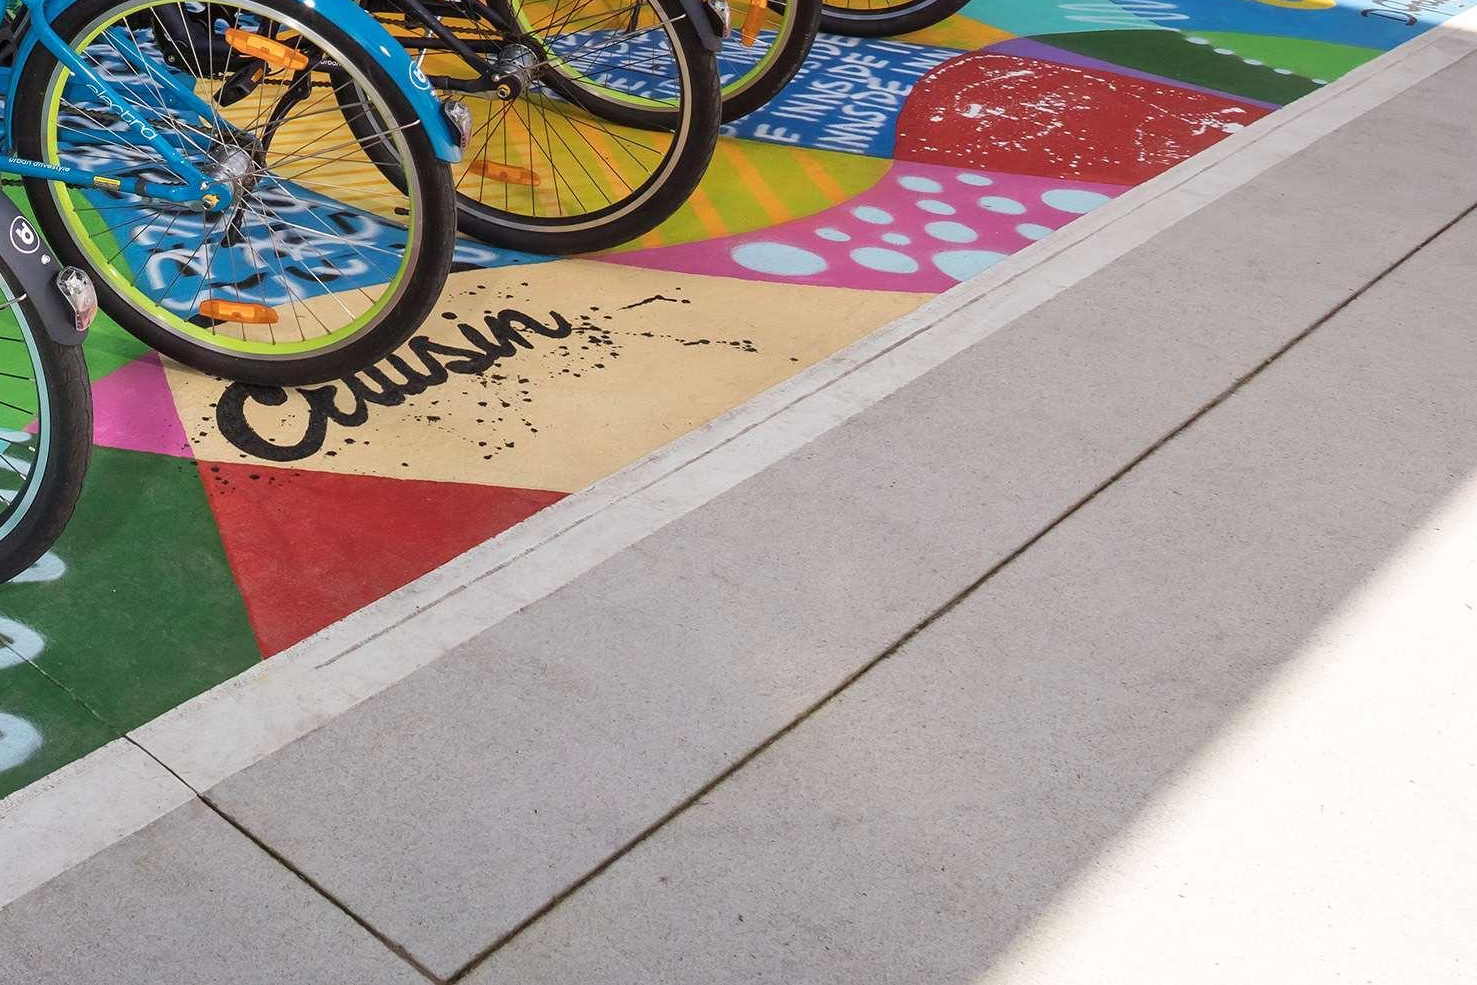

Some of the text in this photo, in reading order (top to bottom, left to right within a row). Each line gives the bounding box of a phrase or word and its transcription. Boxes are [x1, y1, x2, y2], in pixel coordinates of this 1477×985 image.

[86, 84, 158, 140] electra
[770, 52, 890, 122] INNSIDE
[813, 77, 914, 154] INNSIDE
[9, 157, 31, 166] urban
[217, 309, 572, 462] Cruisin
